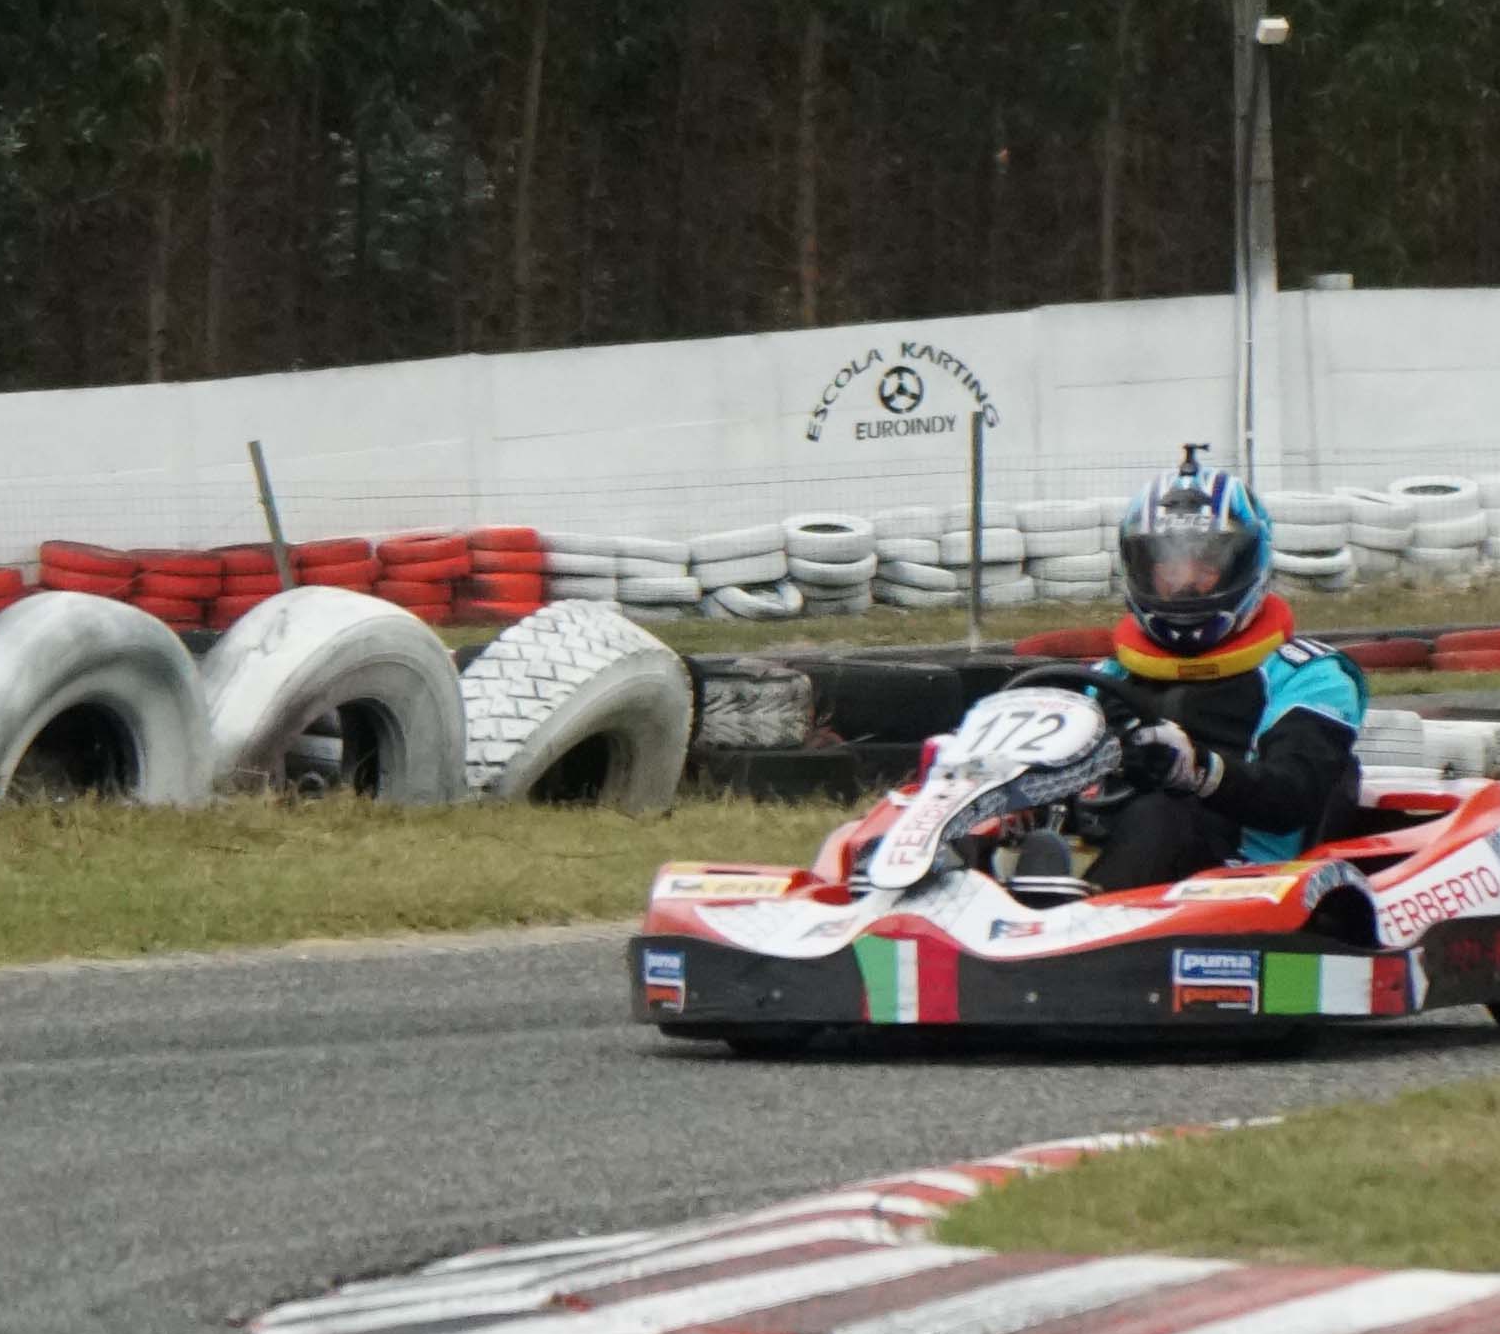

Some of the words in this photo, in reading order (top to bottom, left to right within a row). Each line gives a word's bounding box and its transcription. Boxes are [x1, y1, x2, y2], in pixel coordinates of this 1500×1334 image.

[806, 348, 884, 442] ESCOLA
[900, 341, 1000, 428] KARTING
[855, 415, 956, 441] EUROINDY
[968, 711, 1066, 752] 172
